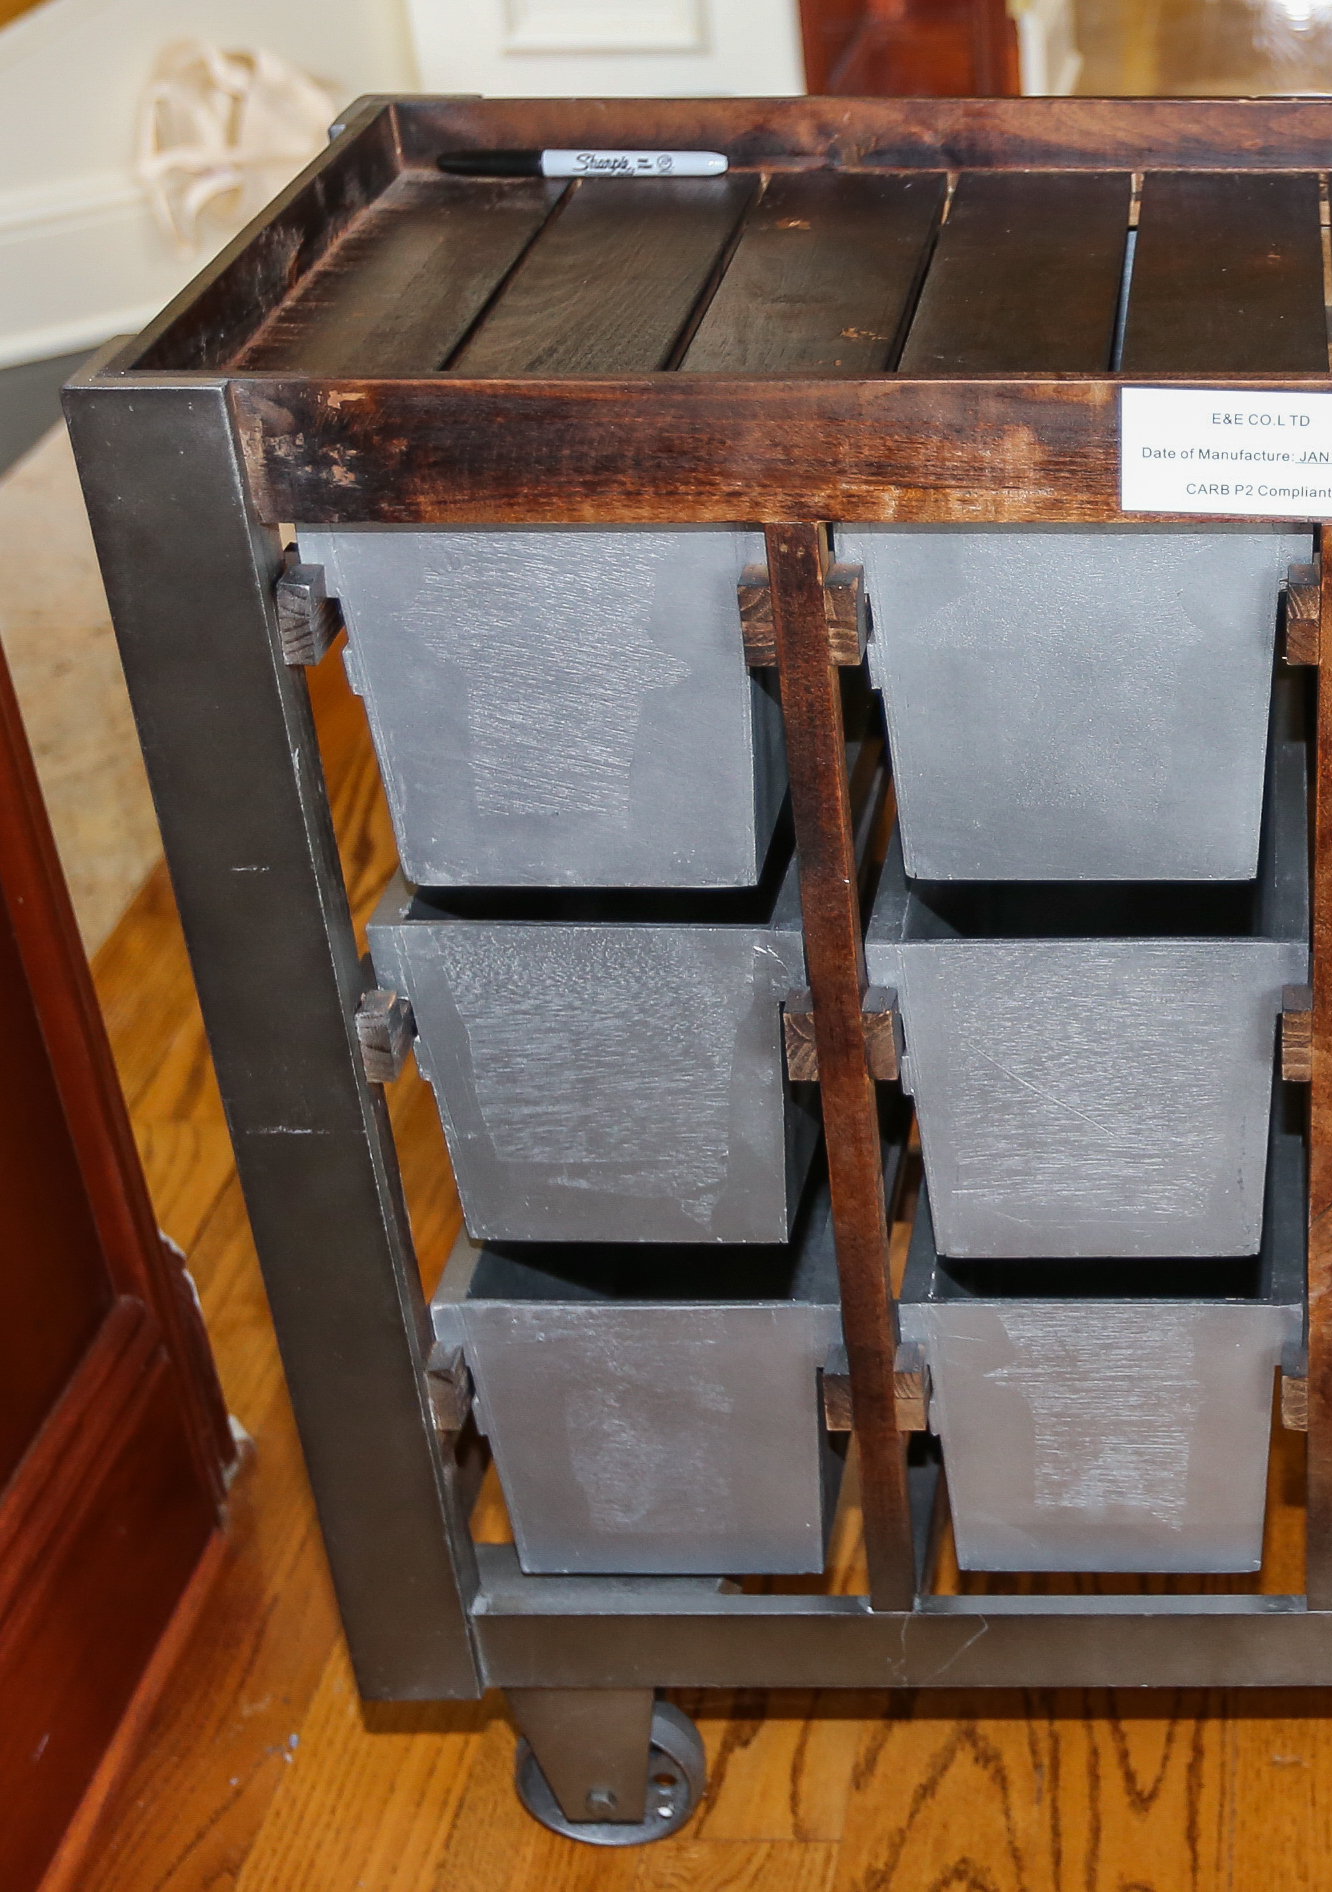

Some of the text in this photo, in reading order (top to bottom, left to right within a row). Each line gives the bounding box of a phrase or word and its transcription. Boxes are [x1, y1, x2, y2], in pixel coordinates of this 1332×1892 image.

[1212, 412, 1244, 426] E&E
[1142, 446, 1176, 460] Date
[1180, 447, 1195, 460] of
[1198, 448, 1295, 463] Manufacture:
[1298, 450, 1331, 464] JAN
[1186, 482, 1332, 500] CARB P2 Compliant
